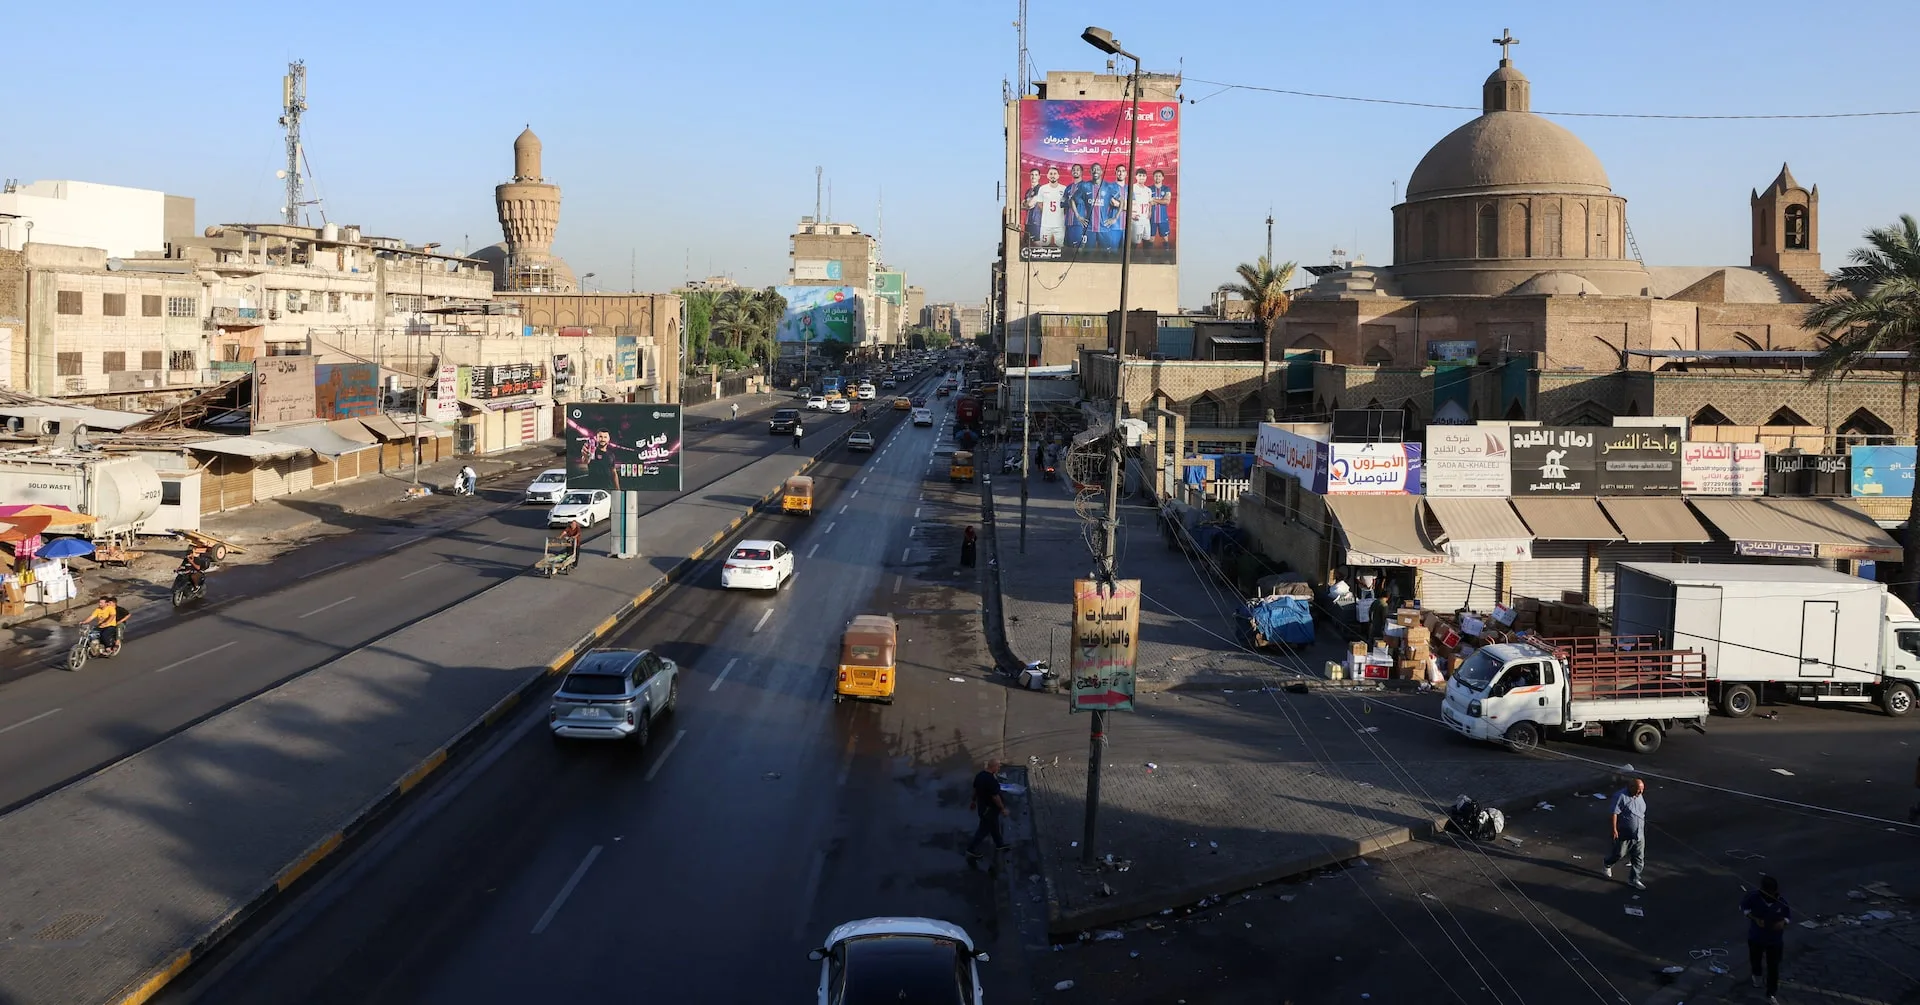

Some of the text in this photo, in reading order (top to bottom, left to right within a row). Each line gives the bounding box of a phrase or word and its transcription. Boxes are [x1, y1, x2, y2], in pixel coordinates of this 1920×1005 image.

[1044, 136, 1070, 145] جيرمان
[1072, 136, 1087, 145] سان
[1064, 146, 1100, 155] للعالمية
[259, 373, 267, 385] 2
[1445, 434, 1470, 444] شركة
[1513, 430, 1593, 448] رمال الخليج
[1601, 433, 1677, 455] واحة النسر
[1434, 445, 1482, 455] صدى الخليج
[1685, 445, 1761, 465] حسن الخفاجي
[1353, 454, 1404, 470] الأمزون
[1775, 456, 1804, 473] الميرزا
[1348, 472, 1397, 485] للتوصيل
[1529, 482, 1555, 491] العطور
[1741, 542, 1800, 552] حسن الخفاجي
